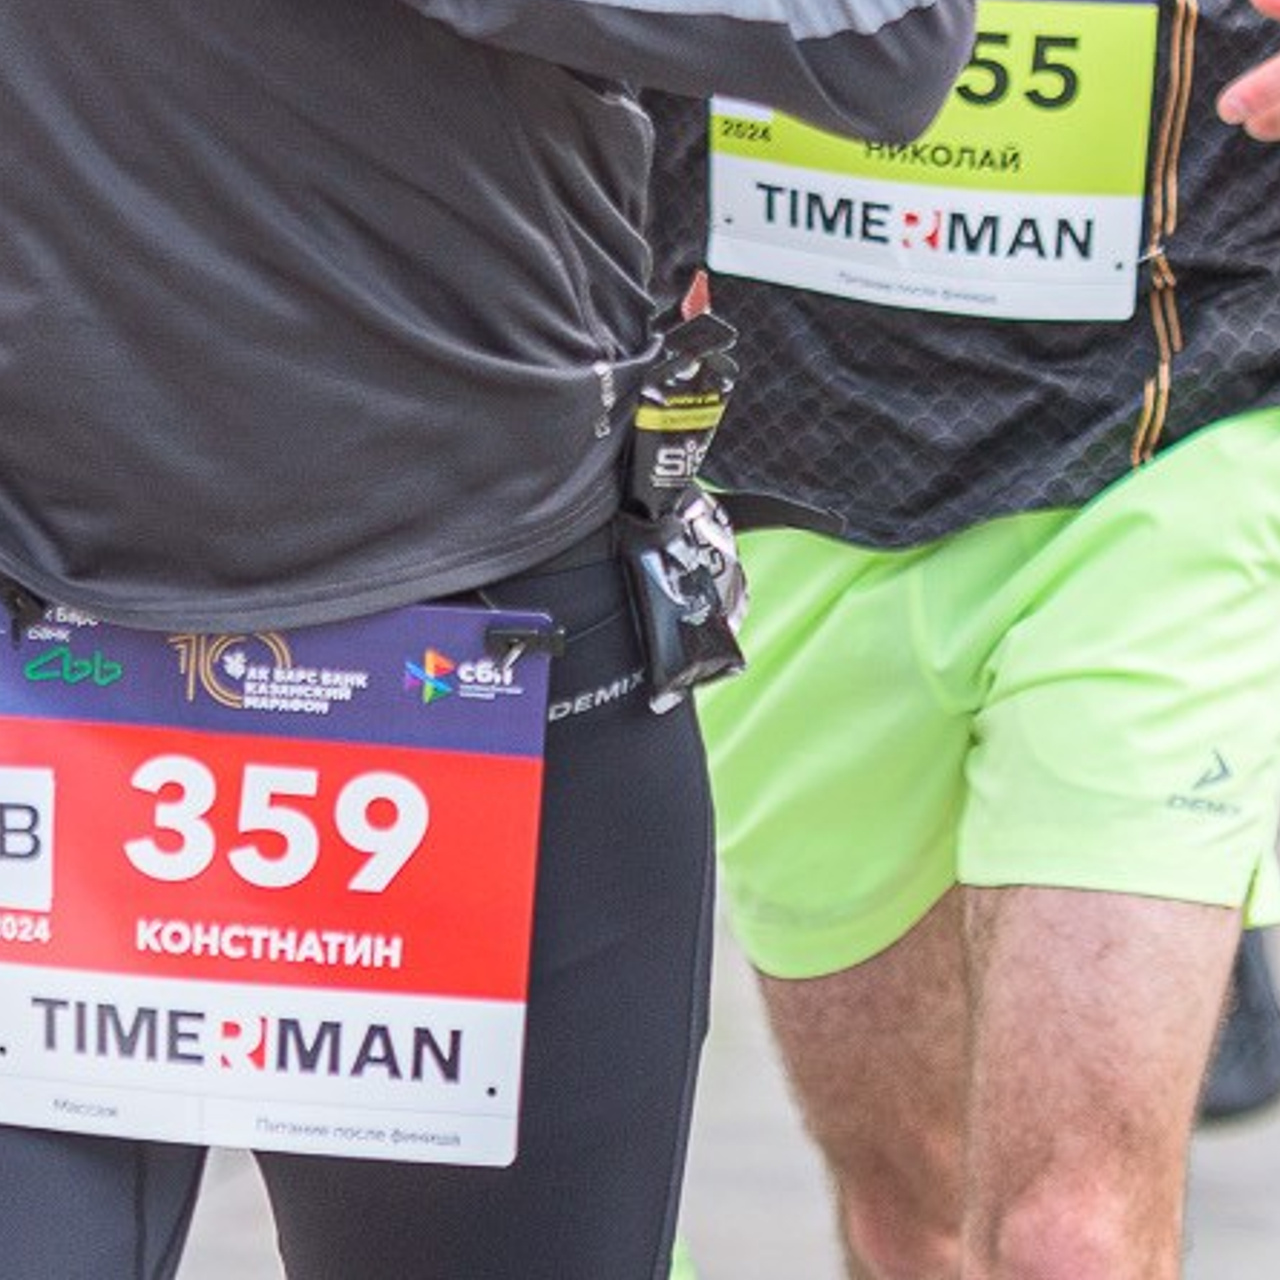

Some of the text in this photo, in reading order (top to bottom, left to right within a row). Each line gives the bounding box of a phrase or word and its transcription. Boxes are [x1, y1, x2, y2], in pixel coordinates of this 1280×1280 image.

[864, 141, 1022, 173] НИКОЛАЙ
[548, 668, 646, 722] DEMIX
[122, 752, 431, 893] 359
[135, 917, 404, 969] КОНСТНАТИН
